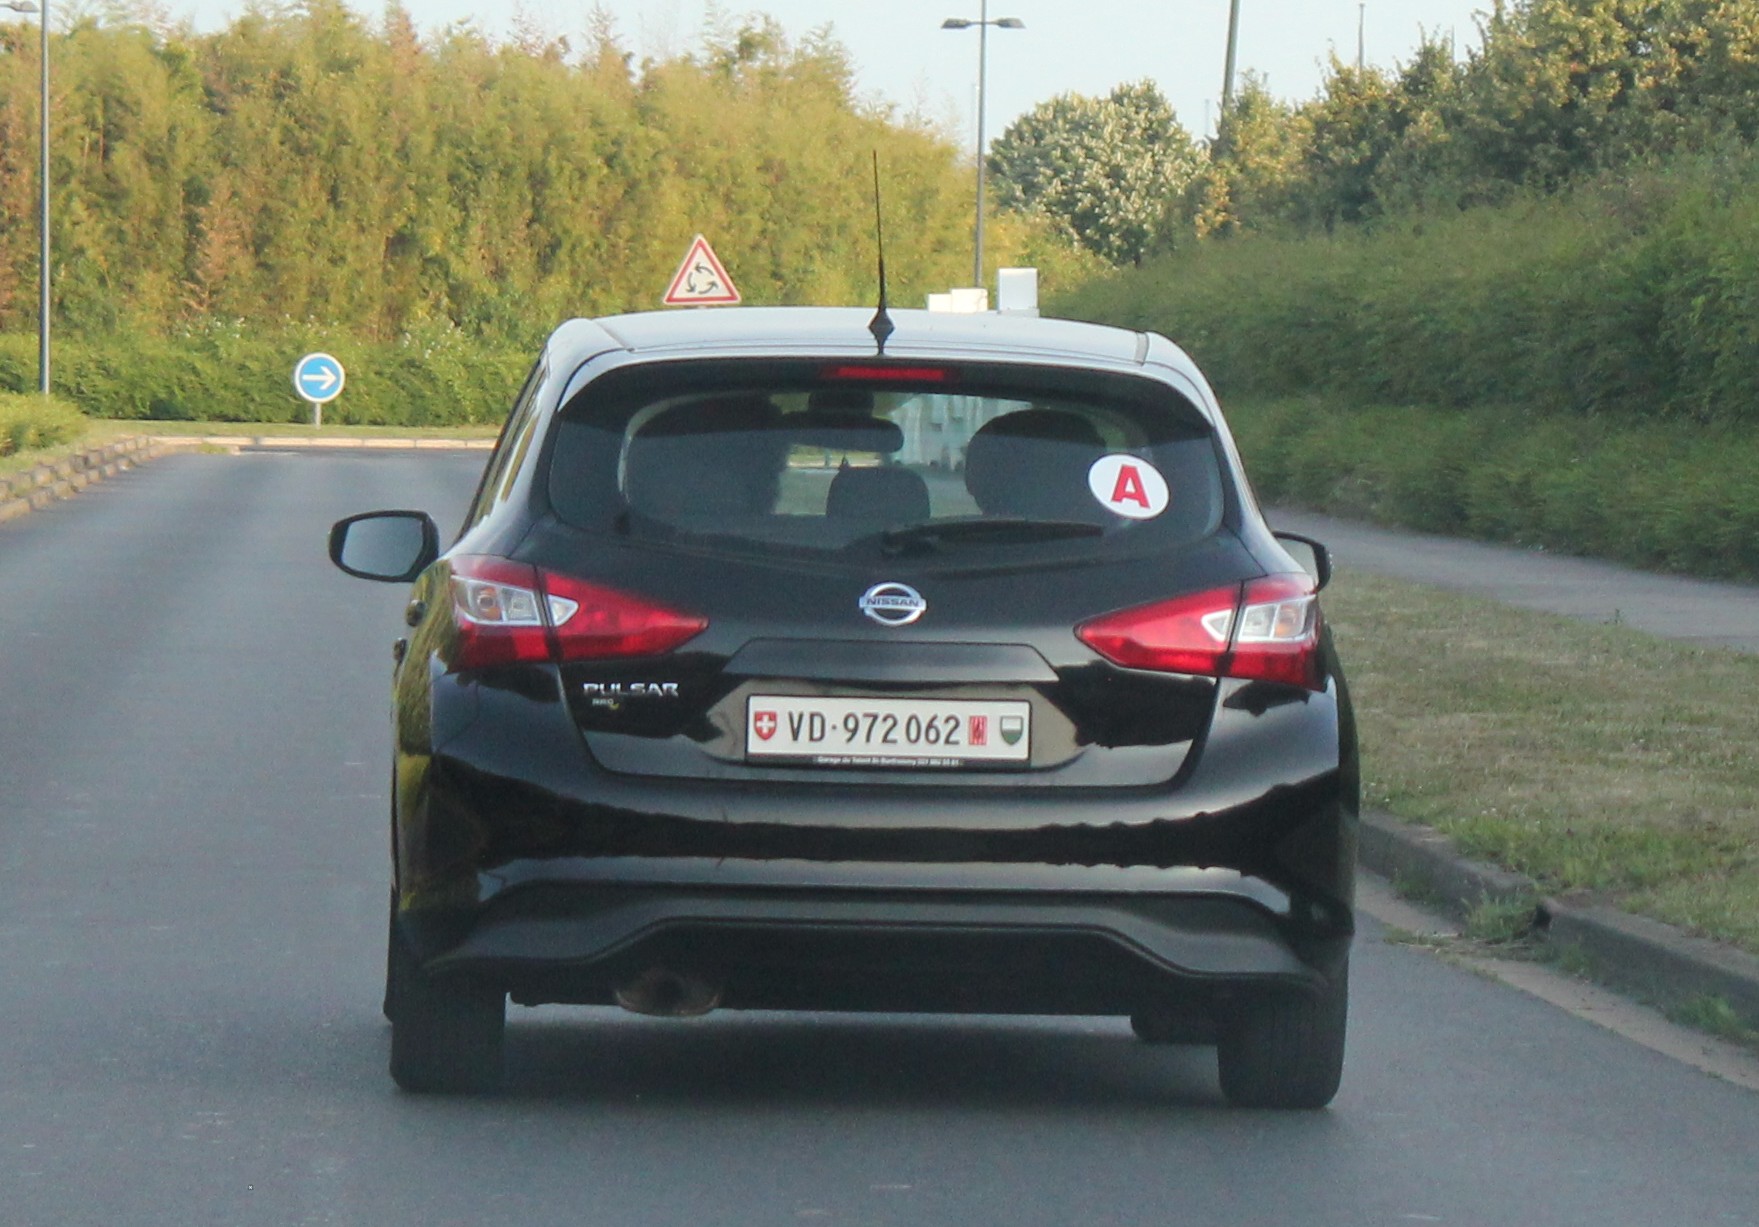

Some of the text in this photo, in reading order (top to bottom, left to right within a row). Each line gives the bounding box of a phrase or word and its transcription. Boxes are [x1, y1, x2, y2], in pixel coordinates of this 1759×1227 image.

[1111, 464, 1151, 509] A
[867, 597, 919, 607] NISSAN
[583, 683, 679, 697] PULSAR
